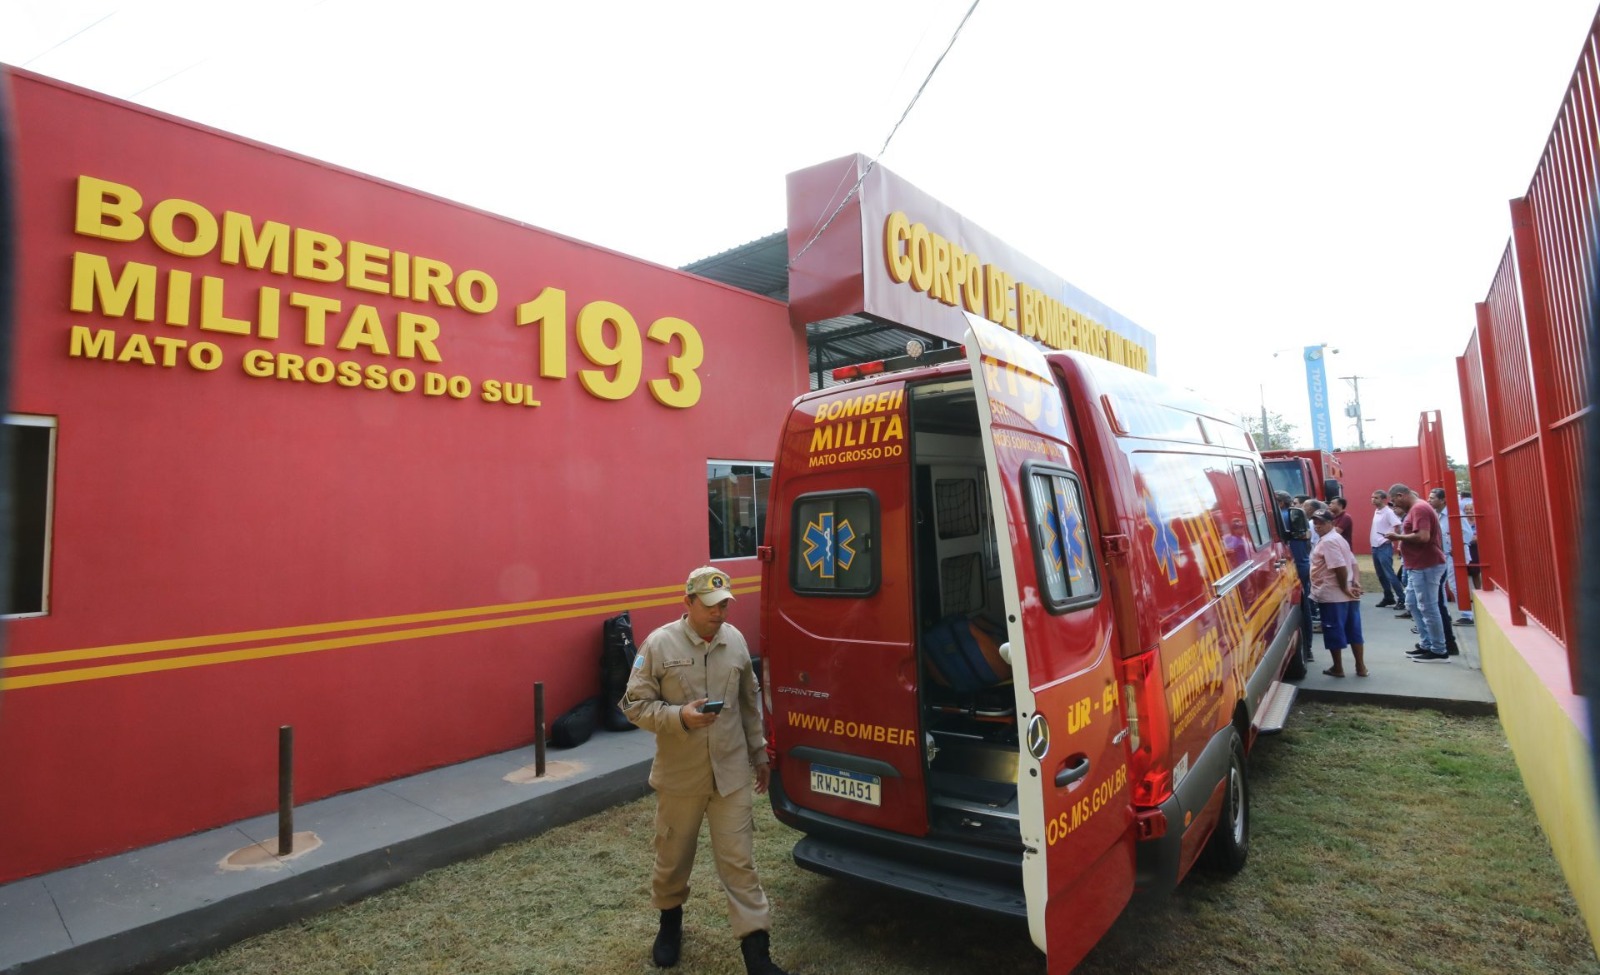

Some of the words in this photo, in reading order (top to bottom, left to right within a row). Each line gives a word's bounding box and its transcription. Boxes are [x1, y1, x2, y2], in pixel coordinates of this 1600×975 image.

[75, 175, 499, 314] BOMBEIRO
[70, 252, 442, 362] MILITAR
[885, 211, 984, 316] CORPO
[983, 263, 1017, 331] DE
[1015, 281, 1108, 360] BOMBEIROS
[1106, 329, 1149, 374] MILITAR
[69, 325, 223, 371] MATO
[243, 349, 415, 393] GROSSO
[423, 371, 472, 399] DO
[481, 378, 541, 408] SUL
[516, 287, 704, 408] 193
[1311, 367, 1324, 409] SOCIAL
[809, 413, 904, 453] MILITA
[809, 455, 837, 468] MATO
[838, 447, 881, 463] GROSSO
[884, 444, 903, 458] DO
[777, 685, 830, 700] SPRINTER
[1199, 625, 1223, 697] 193
[1067, 696, 1092, 735] UR
[1171, 665, 1206, 723] MILITAR
[816, 773, 872, 801] RWJ1A51
[1047, 764, 1128, 846] OS.MS.GOV.BR
